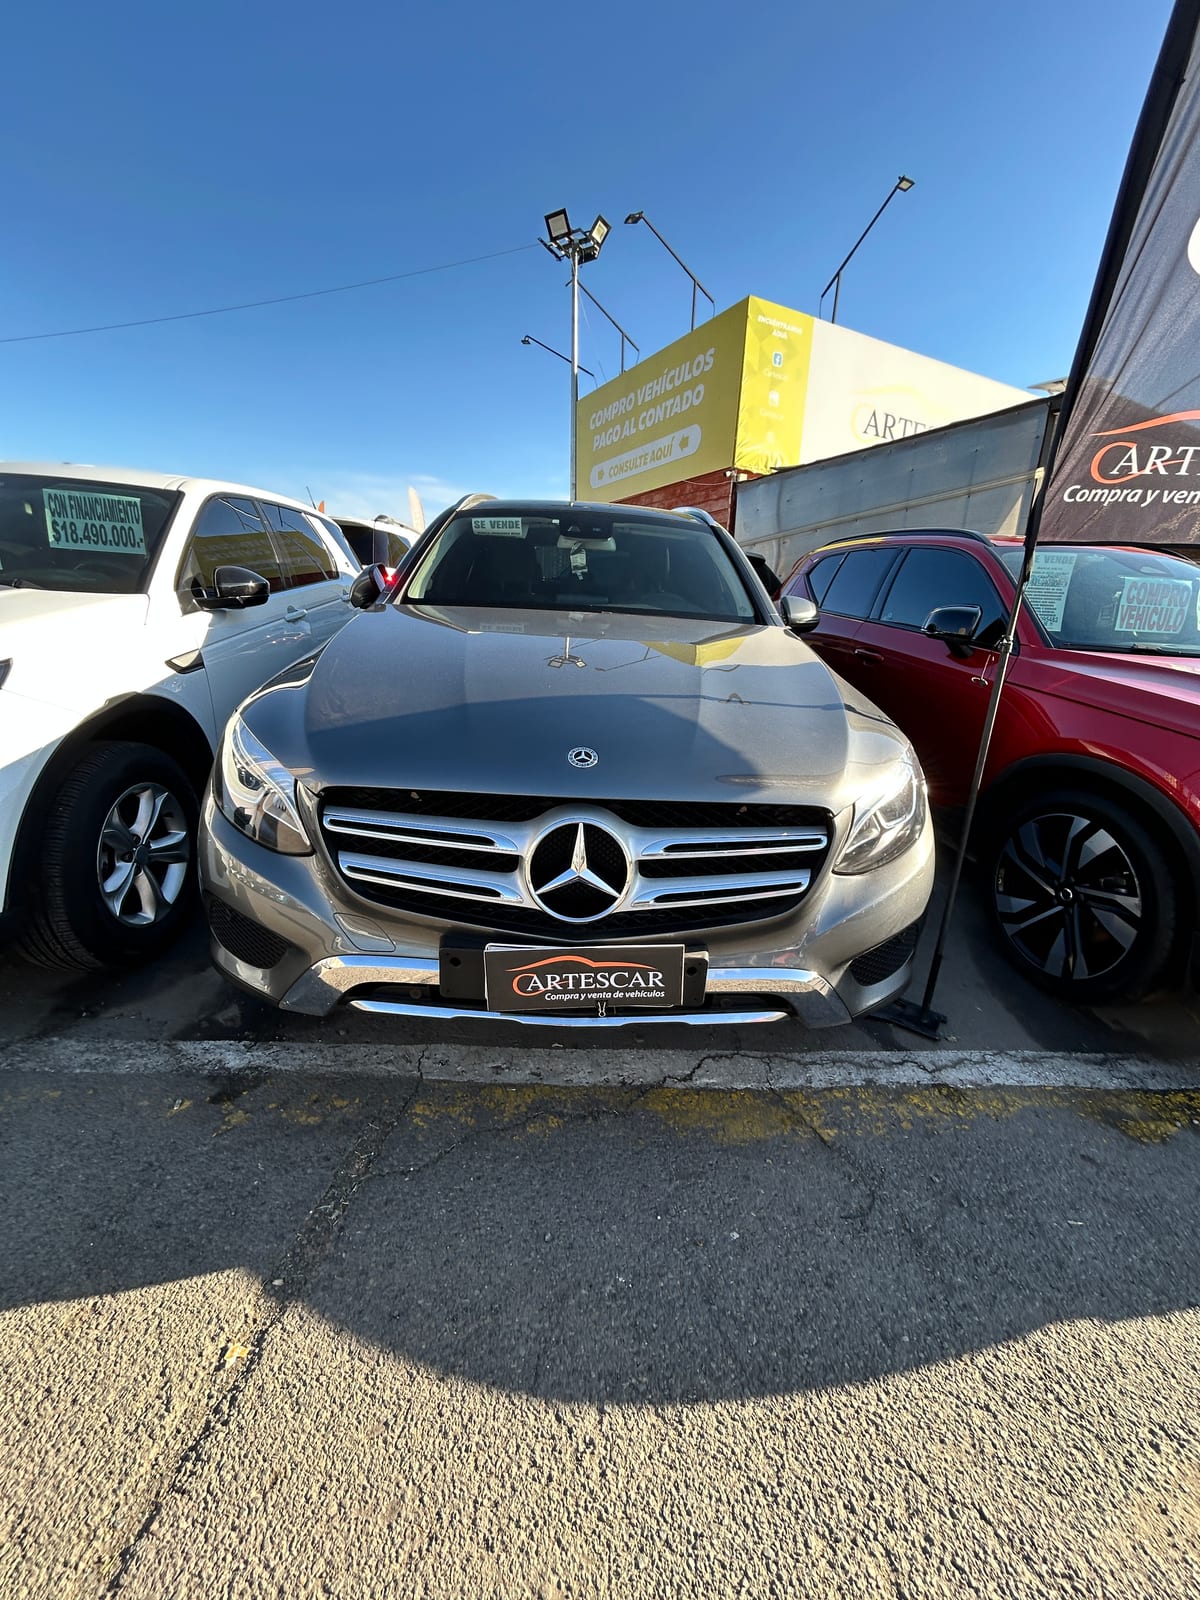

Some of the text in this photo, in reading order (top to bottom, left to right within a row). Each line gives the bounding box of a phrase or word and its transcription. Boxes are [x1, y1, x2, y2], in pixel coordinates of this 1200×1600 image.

[590, 347, 716, 430] COMPRO VEHÍCULOS
[592, 383, 705, 452] PAGO AL CONTADO
[608, 436, 674, 478] CONSULTE AQUÍ
[47, 493, 140, 525] CON FINANCIAMIENTO
[1063, 484, 1143, 507] Compra
[1140, 489, 1160, 508] y
[51, 519, 144, 549] $18.490.000.-
[473, 520, 521, 530] SE VENDE
[1126, 581, 1191, 608] COMPRO
[1118, 604, 1185, 632] VEHICULO
[512, 971, 666, 997] CARTESCAR
[545, 989, 665, 1001] Compra y venta de vehículos
